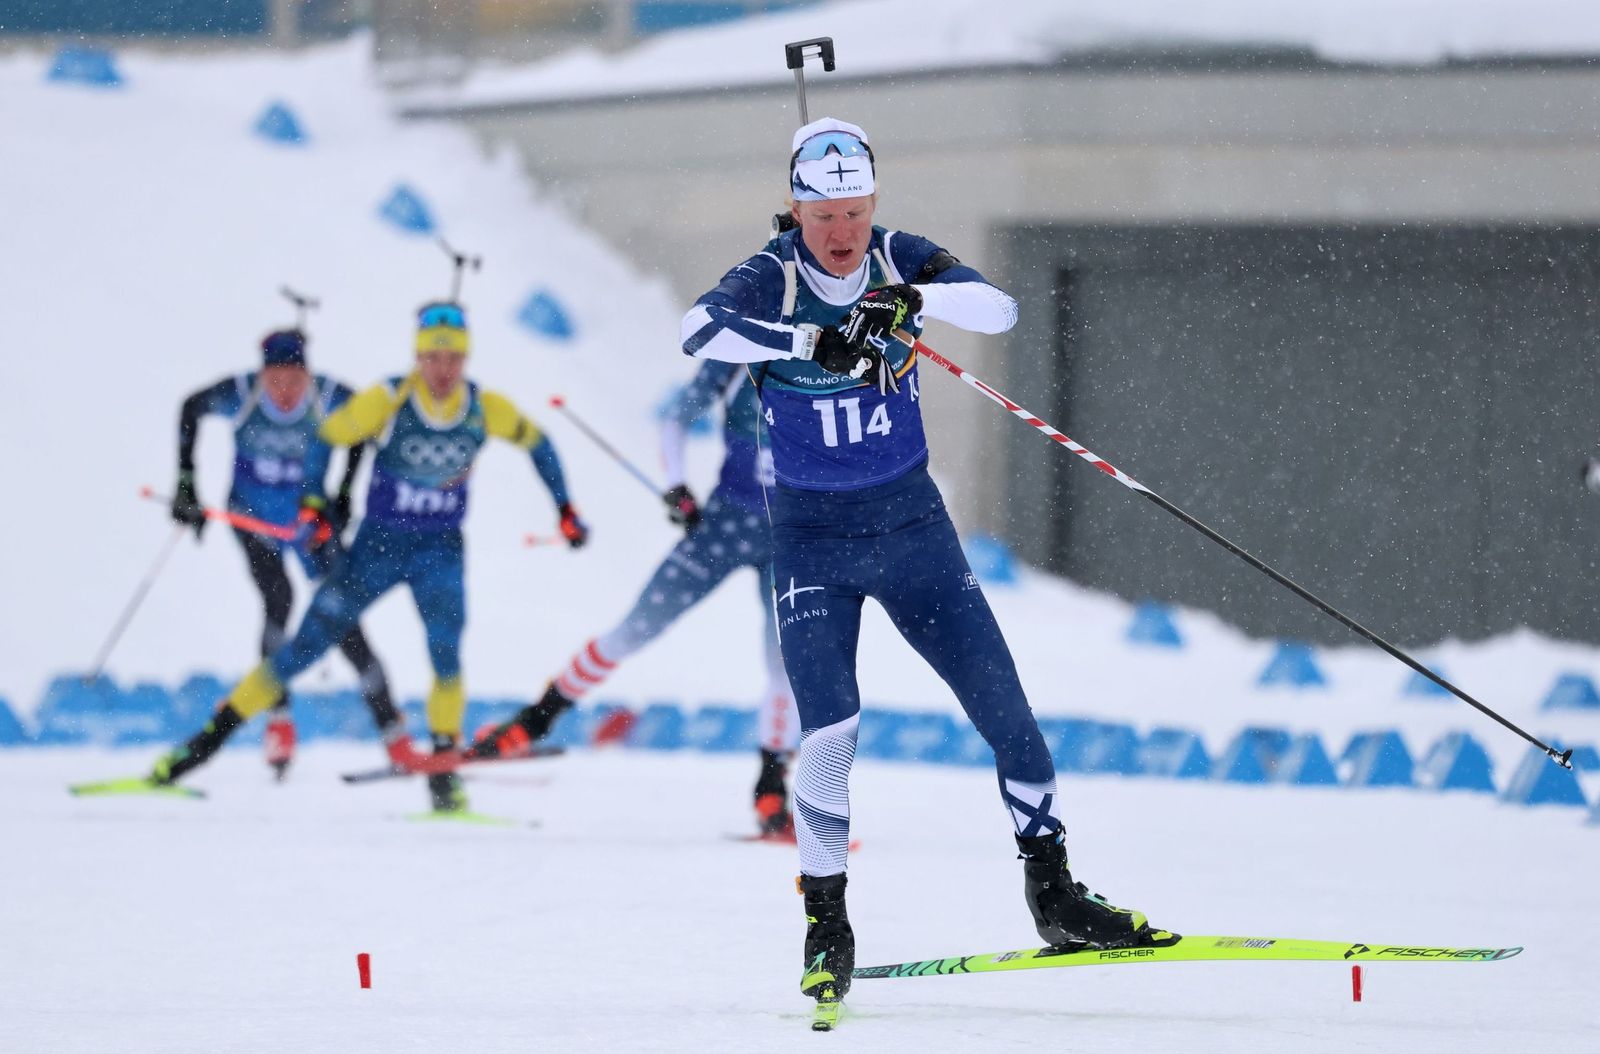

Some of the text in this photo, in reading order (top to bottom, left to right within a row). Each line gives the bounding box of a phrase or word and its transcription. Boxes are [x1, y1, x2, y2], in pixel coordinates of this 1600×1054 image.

[826, 185, 863, 193] FINLAND
[793, 376, 840, 385] MILANO
[1099, 949, 1155, 960] FISCHER
[1376, 947, 1492, 959] FISCHER
